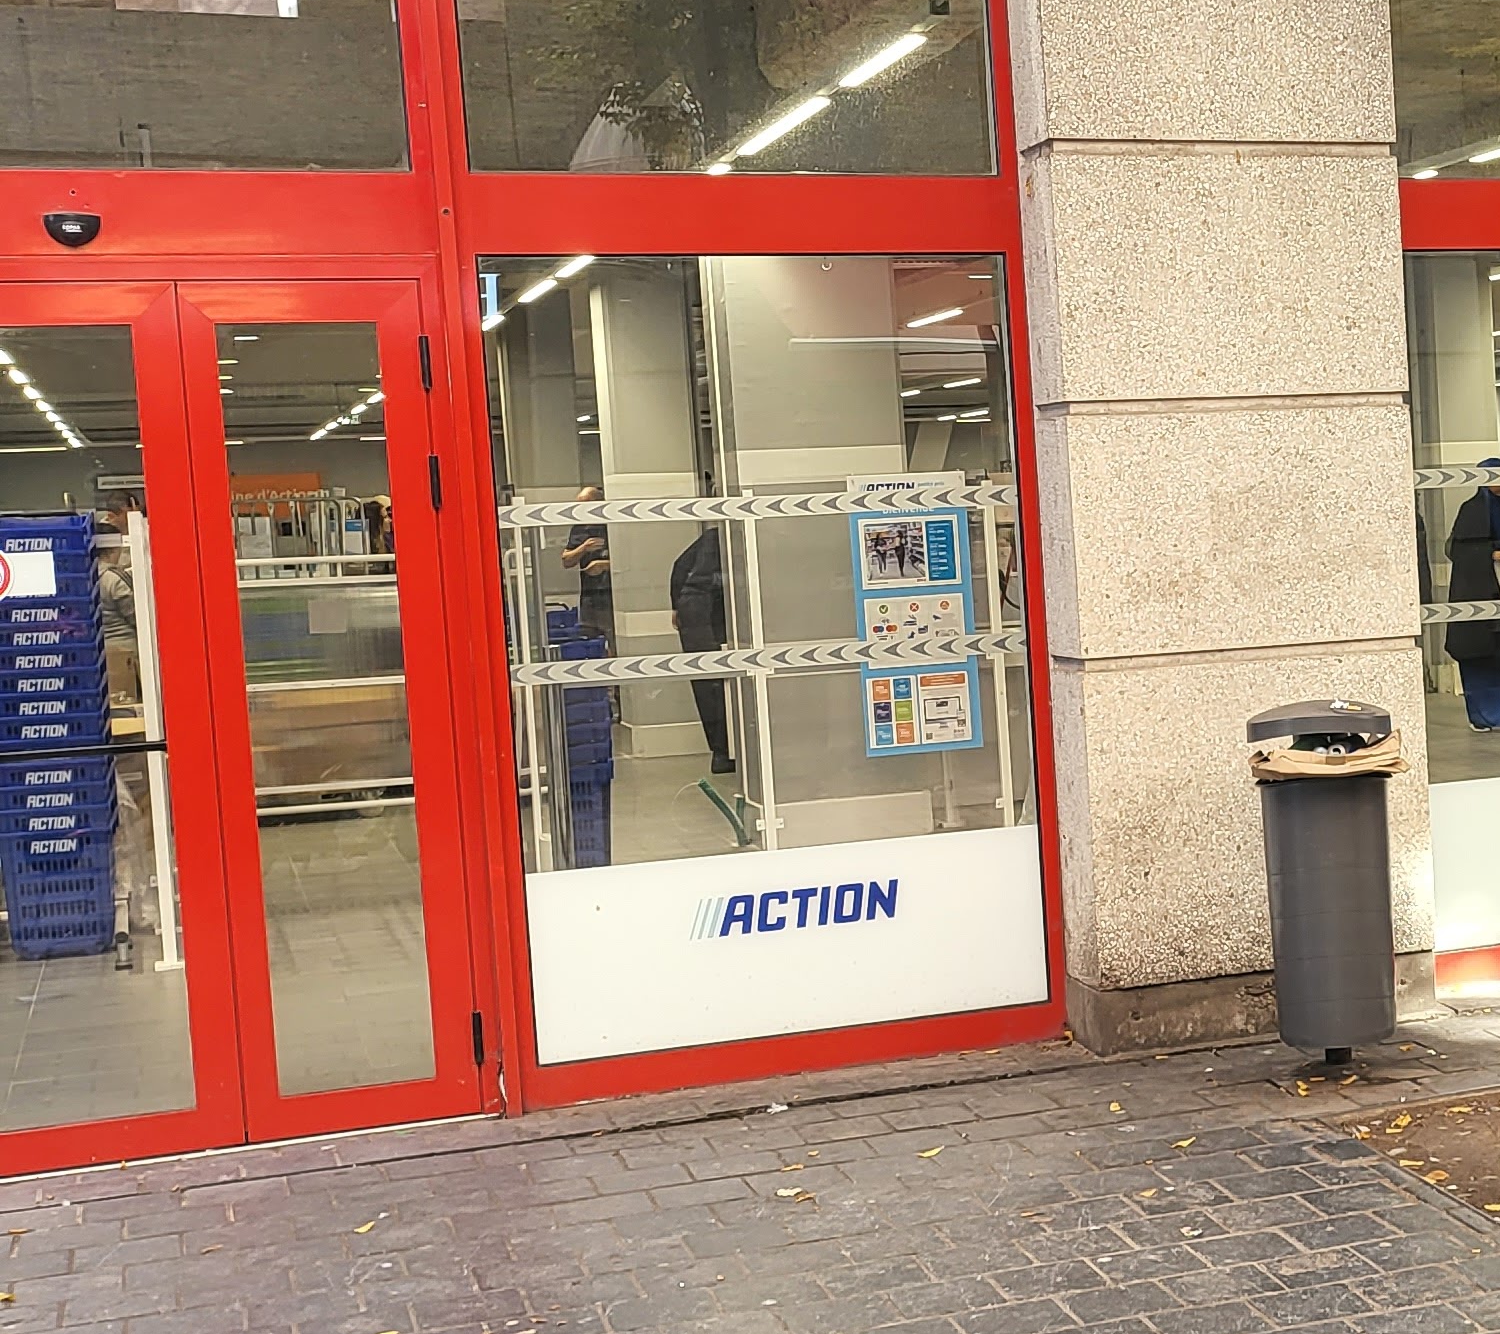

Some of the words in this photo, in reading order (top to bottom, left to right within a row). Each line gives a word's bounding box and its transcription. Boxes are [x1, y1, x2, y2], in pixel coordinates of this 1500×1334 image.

[5, 537, 53, 552] ACTION
[11, 608, 58, 623] ACTION
[13, 631, 60, 646] ACTION
[15, 654, 62, 670] ACTION
[17, 677, 65, 693] ACTION
[19, 700, 66, 716] ACTION
[21, 723, 68, 740] ACTION
[25, 769, 72, 786] ACTION
[26, 793, 74, 809] ACTION
[28, 815, 76, 832] ACTION
[30, 838, 78, 855] ACTION
[719, 878, 899, 938] ACTION
